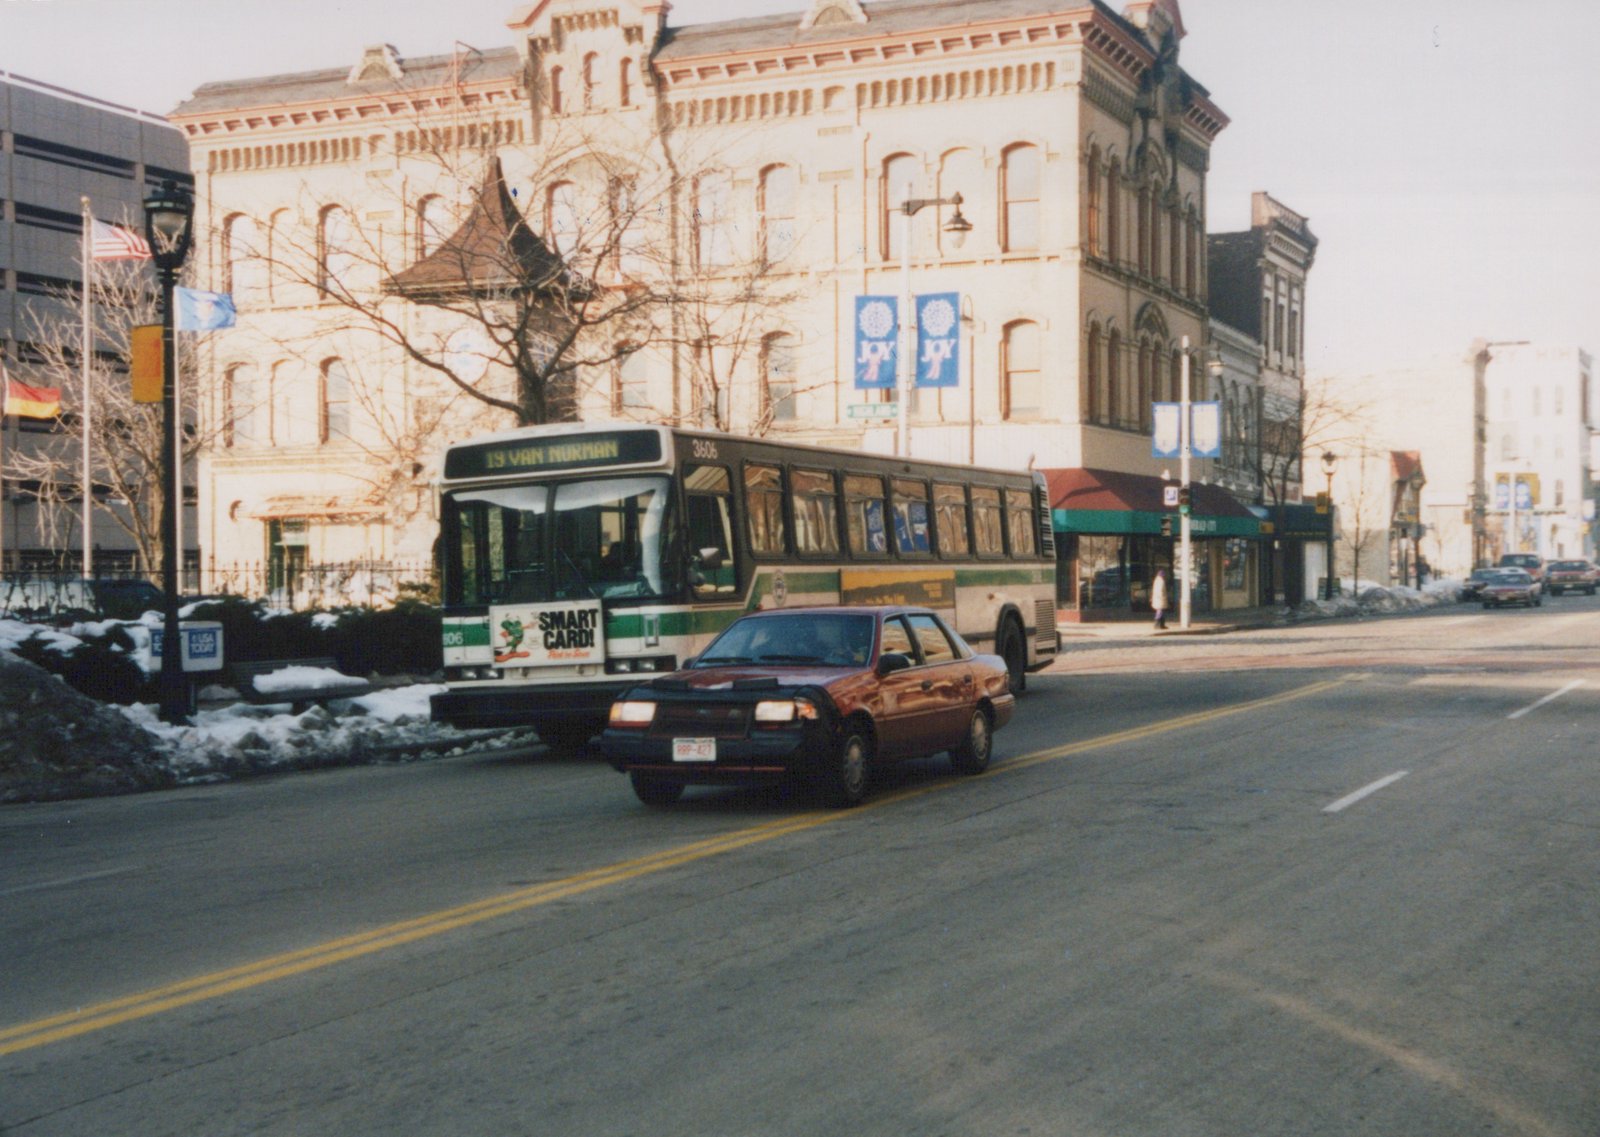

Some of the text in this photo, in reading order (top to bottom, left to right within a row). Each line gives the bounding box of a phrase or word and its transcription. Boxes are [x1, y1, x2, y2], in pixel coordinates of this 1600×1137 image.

[858, 341, 896, 363] JOY
[921, 338, 957, 362] JOY
[487, 450, 505, 469] 19
[508, 446, 544, 467] VAN
[692, 438, 719, 460] 3606
[538, 608, 599, 632] SMART
[543, 627, 595, 651] CARD!
